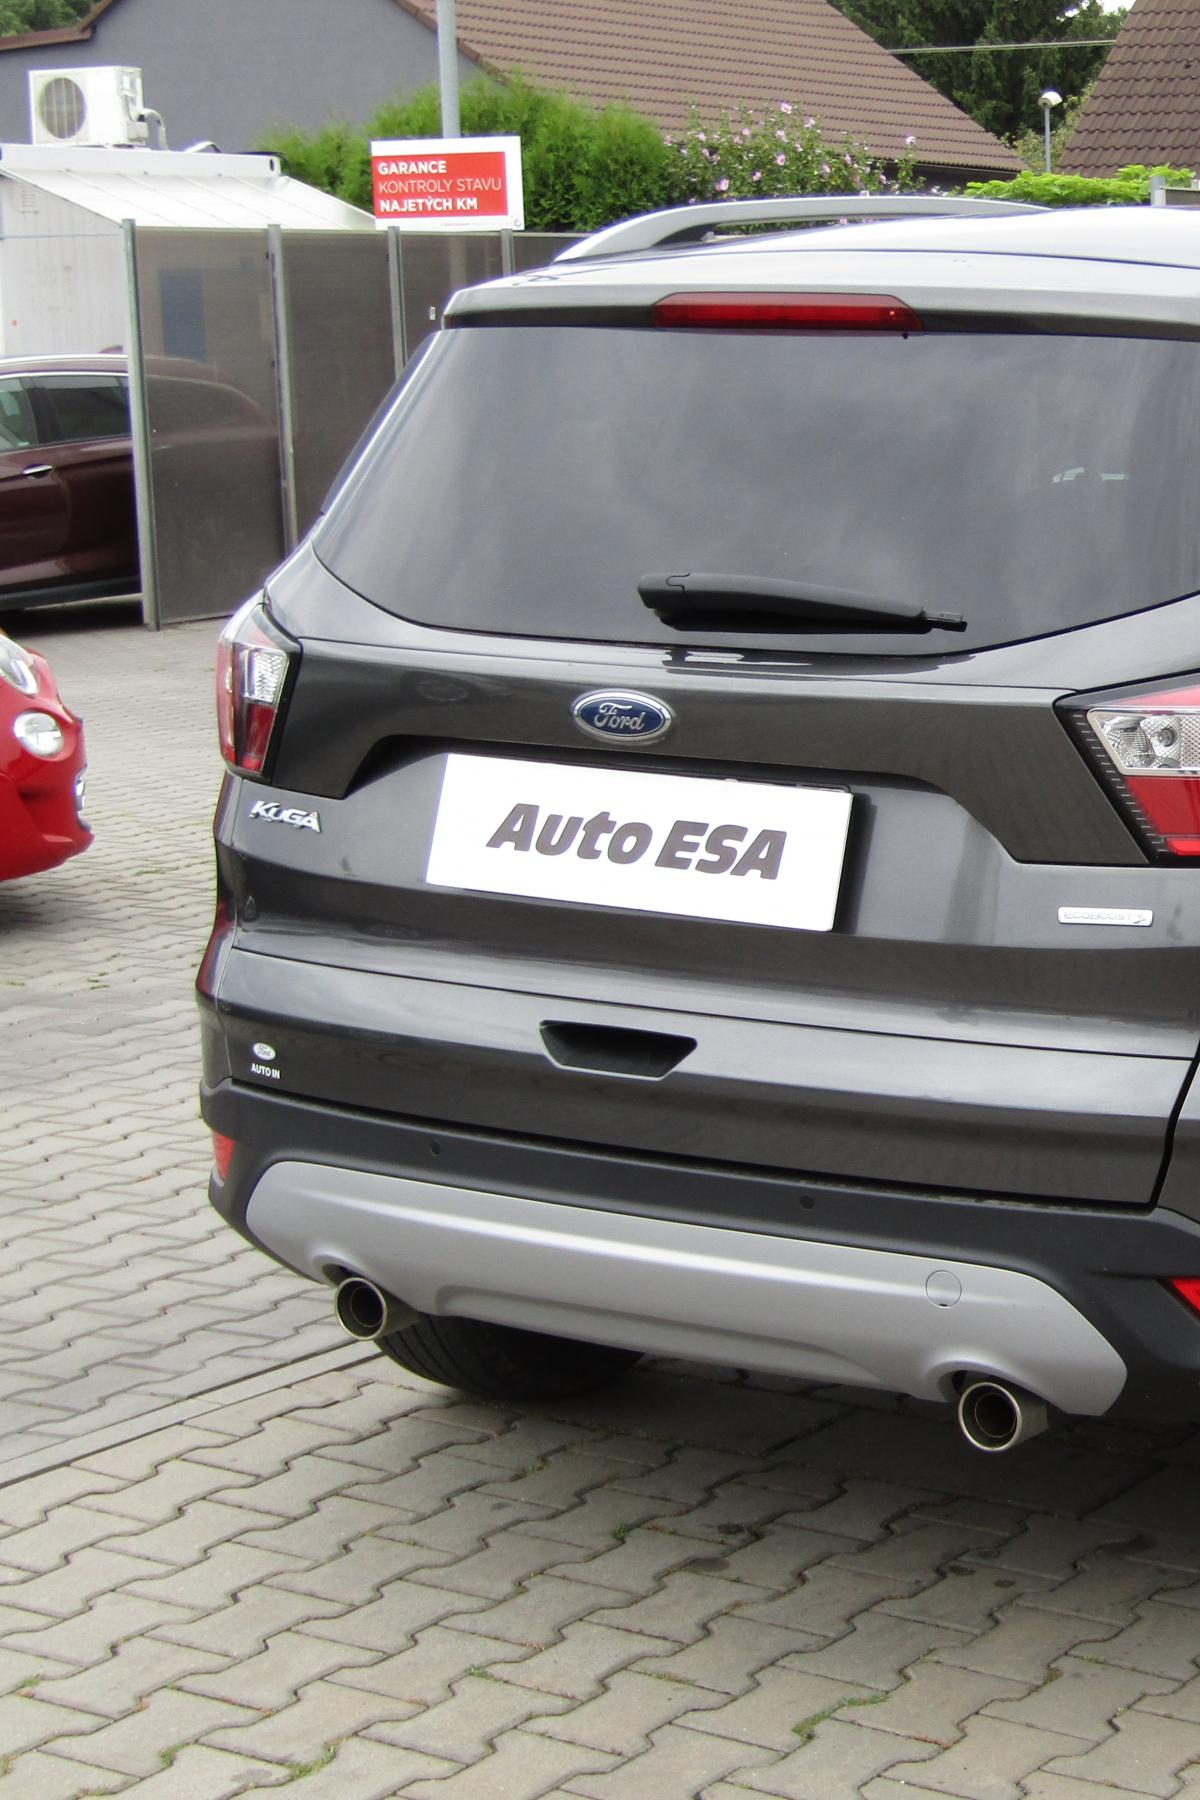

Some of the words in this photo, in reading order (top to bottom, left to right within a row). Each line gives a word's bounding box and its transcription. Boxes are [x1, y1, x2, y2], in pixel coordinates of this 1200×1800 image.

[378, 160, 446, 175] GARANCE
[379, 179, 453, 194] KONTROLY
[457, 177, 502, 192] STAVU
[380, 196, 452, 212] NAJETÝCH
[456, 197, 478, 210] KM
[594, 702, 646, 730] Ford
[249, 800, 321, 833] KUGA
[485, 803, 653, 864] Auto
[655, 820, 787, 880] ESA
[252, 1063, 271, 1076] AUTO
[272, 1069, 280, 1079] IN
